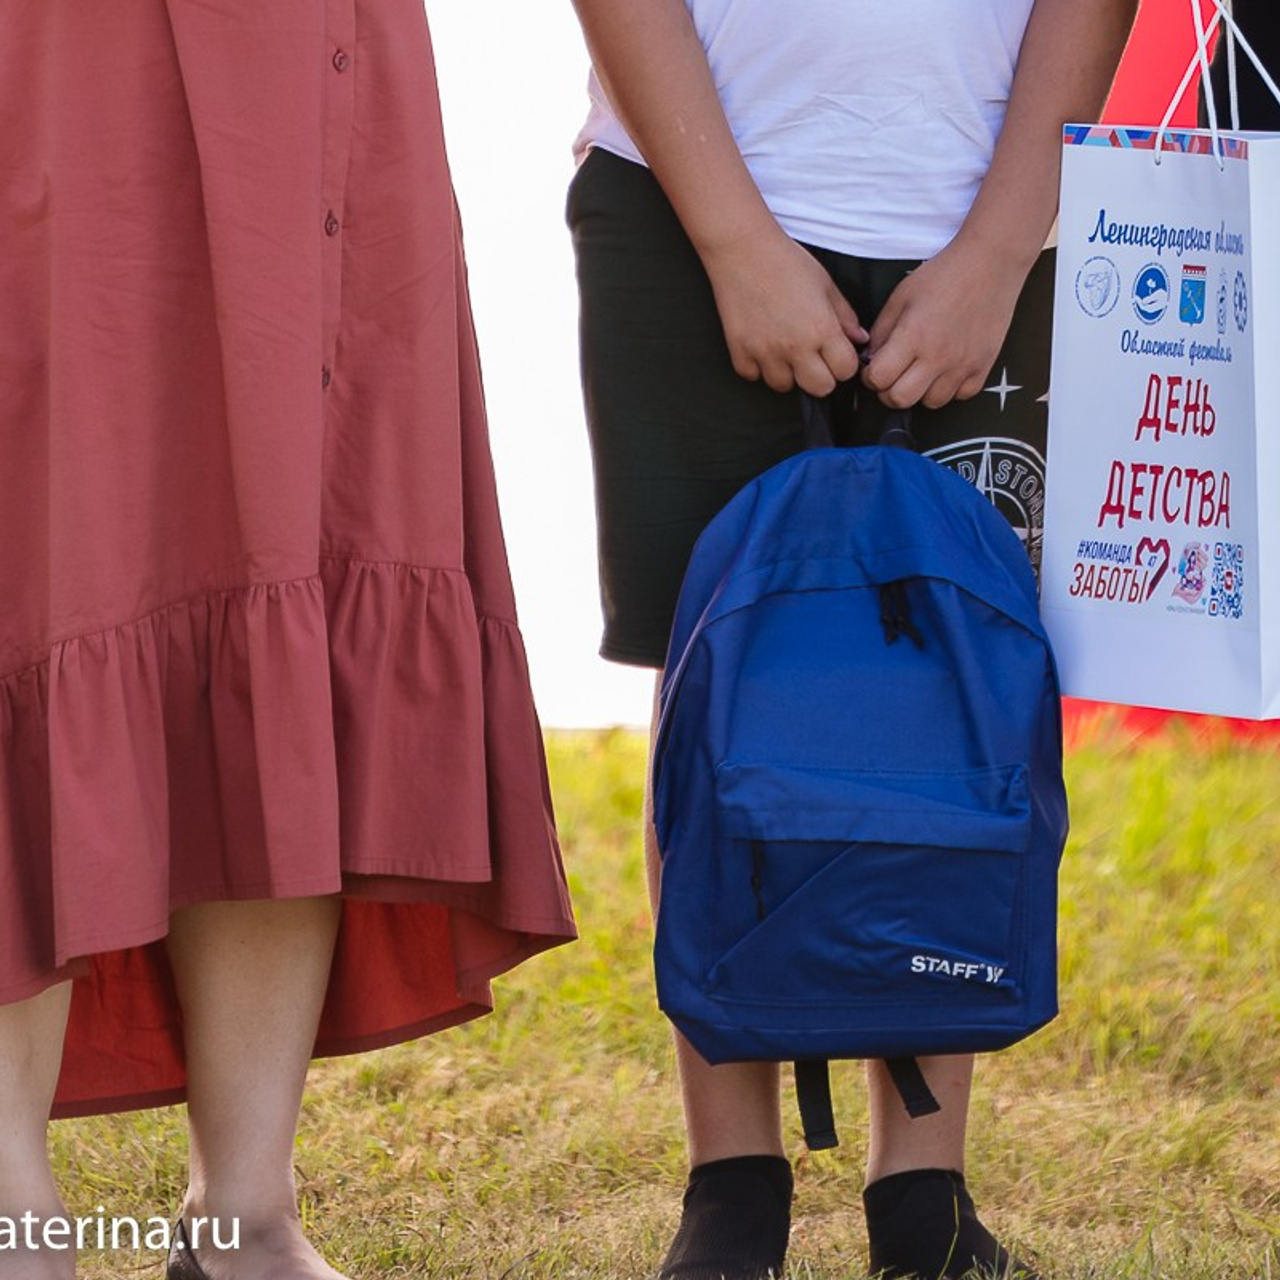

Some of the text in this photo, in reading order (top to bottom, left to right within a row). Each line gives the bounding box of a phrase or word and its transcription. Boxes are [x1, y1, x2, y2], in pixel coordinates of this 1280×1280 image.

[1088, 208, 1211, 257] Ленинградская
[1121, 329, 1232, 366] Областной фестиваль
[1135, 373, 1216, 442] ДЕНЬ
[1098, 460, 1230, 529] ДЕТСТВА
[1077, 540, 1133, 564] #КОМАНДА
[1147, 555, 1158, 568] 47
[1069, 562, 1148, 604] ЗАБОТЫ
